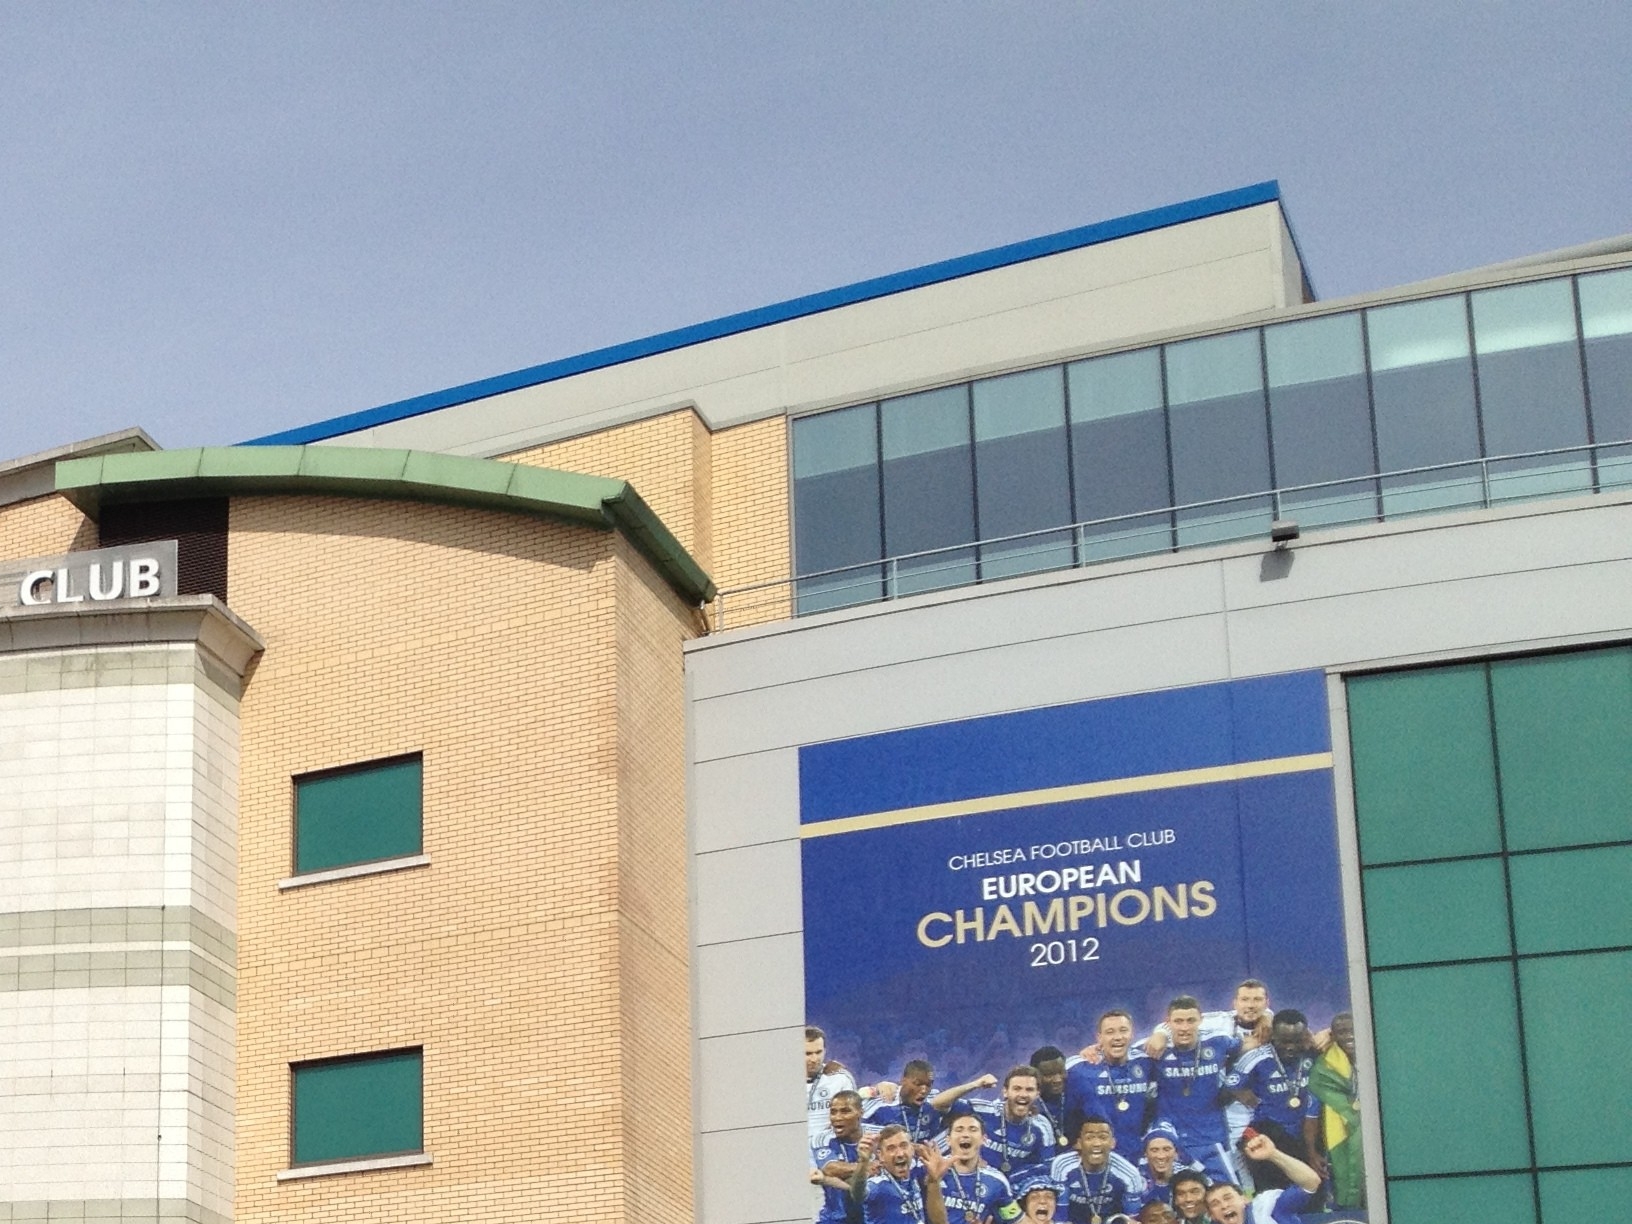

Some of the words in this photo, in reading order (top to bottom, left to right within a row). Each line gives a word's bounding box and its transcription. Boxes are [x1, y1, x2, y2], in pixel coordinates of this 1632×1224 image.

[20, 556, 162, 606] CLUB
[948, 847, 1026, 871] CHELSEA
[1030, 835, 1122, 860] FOOTBALL
[1127, 828, 1177, 848] CLUB
[981, 859, 1142, 901] EUROPEAN
[917, 879, 1218, 949] CHAMPIONS
[1029, 937, 1100, 967] 2012
